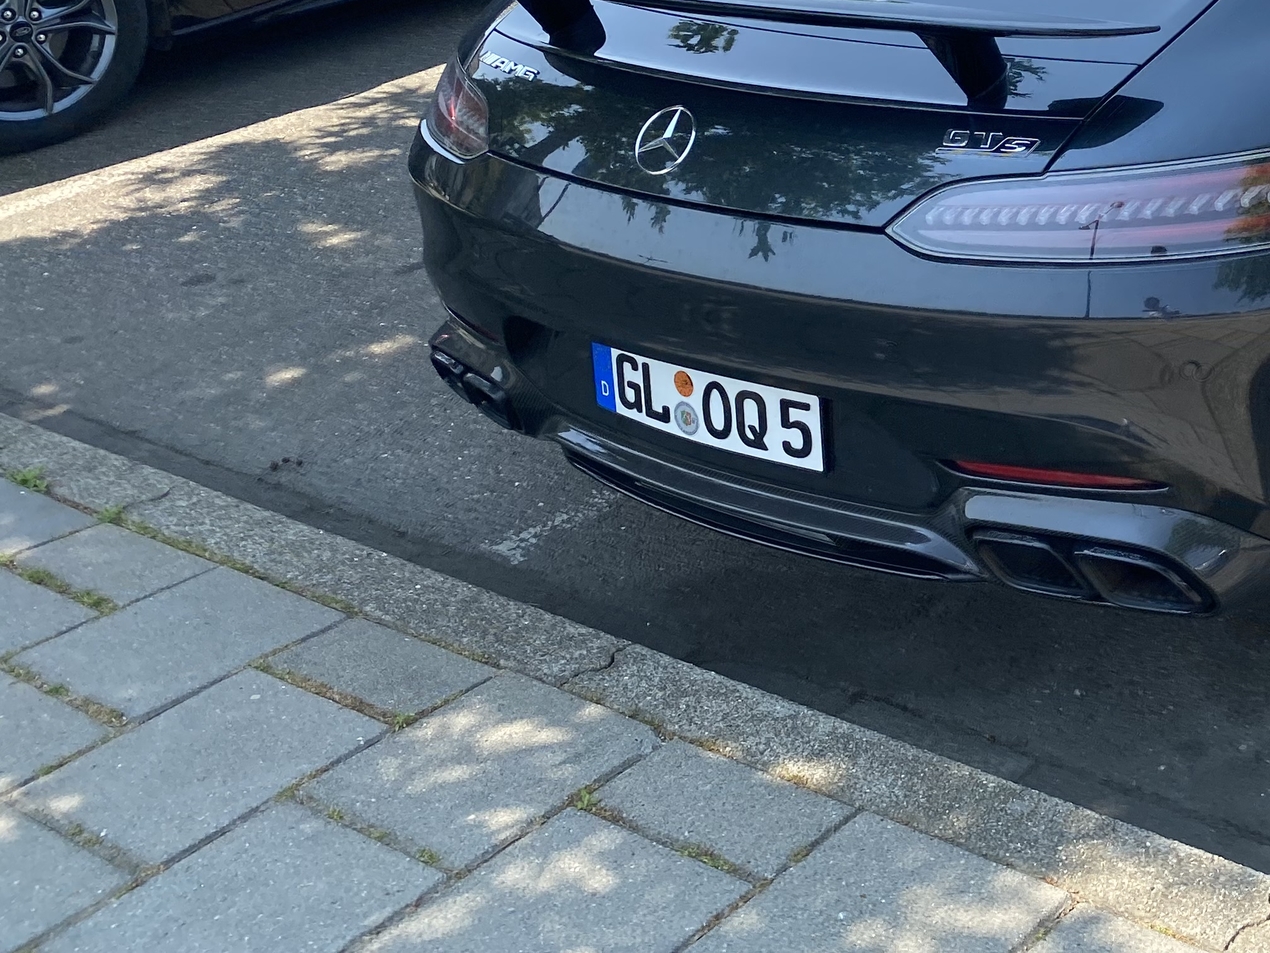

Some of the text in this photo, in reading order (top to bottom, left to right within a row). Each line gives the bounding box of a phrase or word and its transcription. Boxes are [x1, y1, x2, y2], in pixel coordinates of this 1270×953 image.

[489, 56, 540, 82] AMG
[601, 380, 609, 396] D
[616, 353, 670, 423] GL
[779, 398, 813, 459] 5
